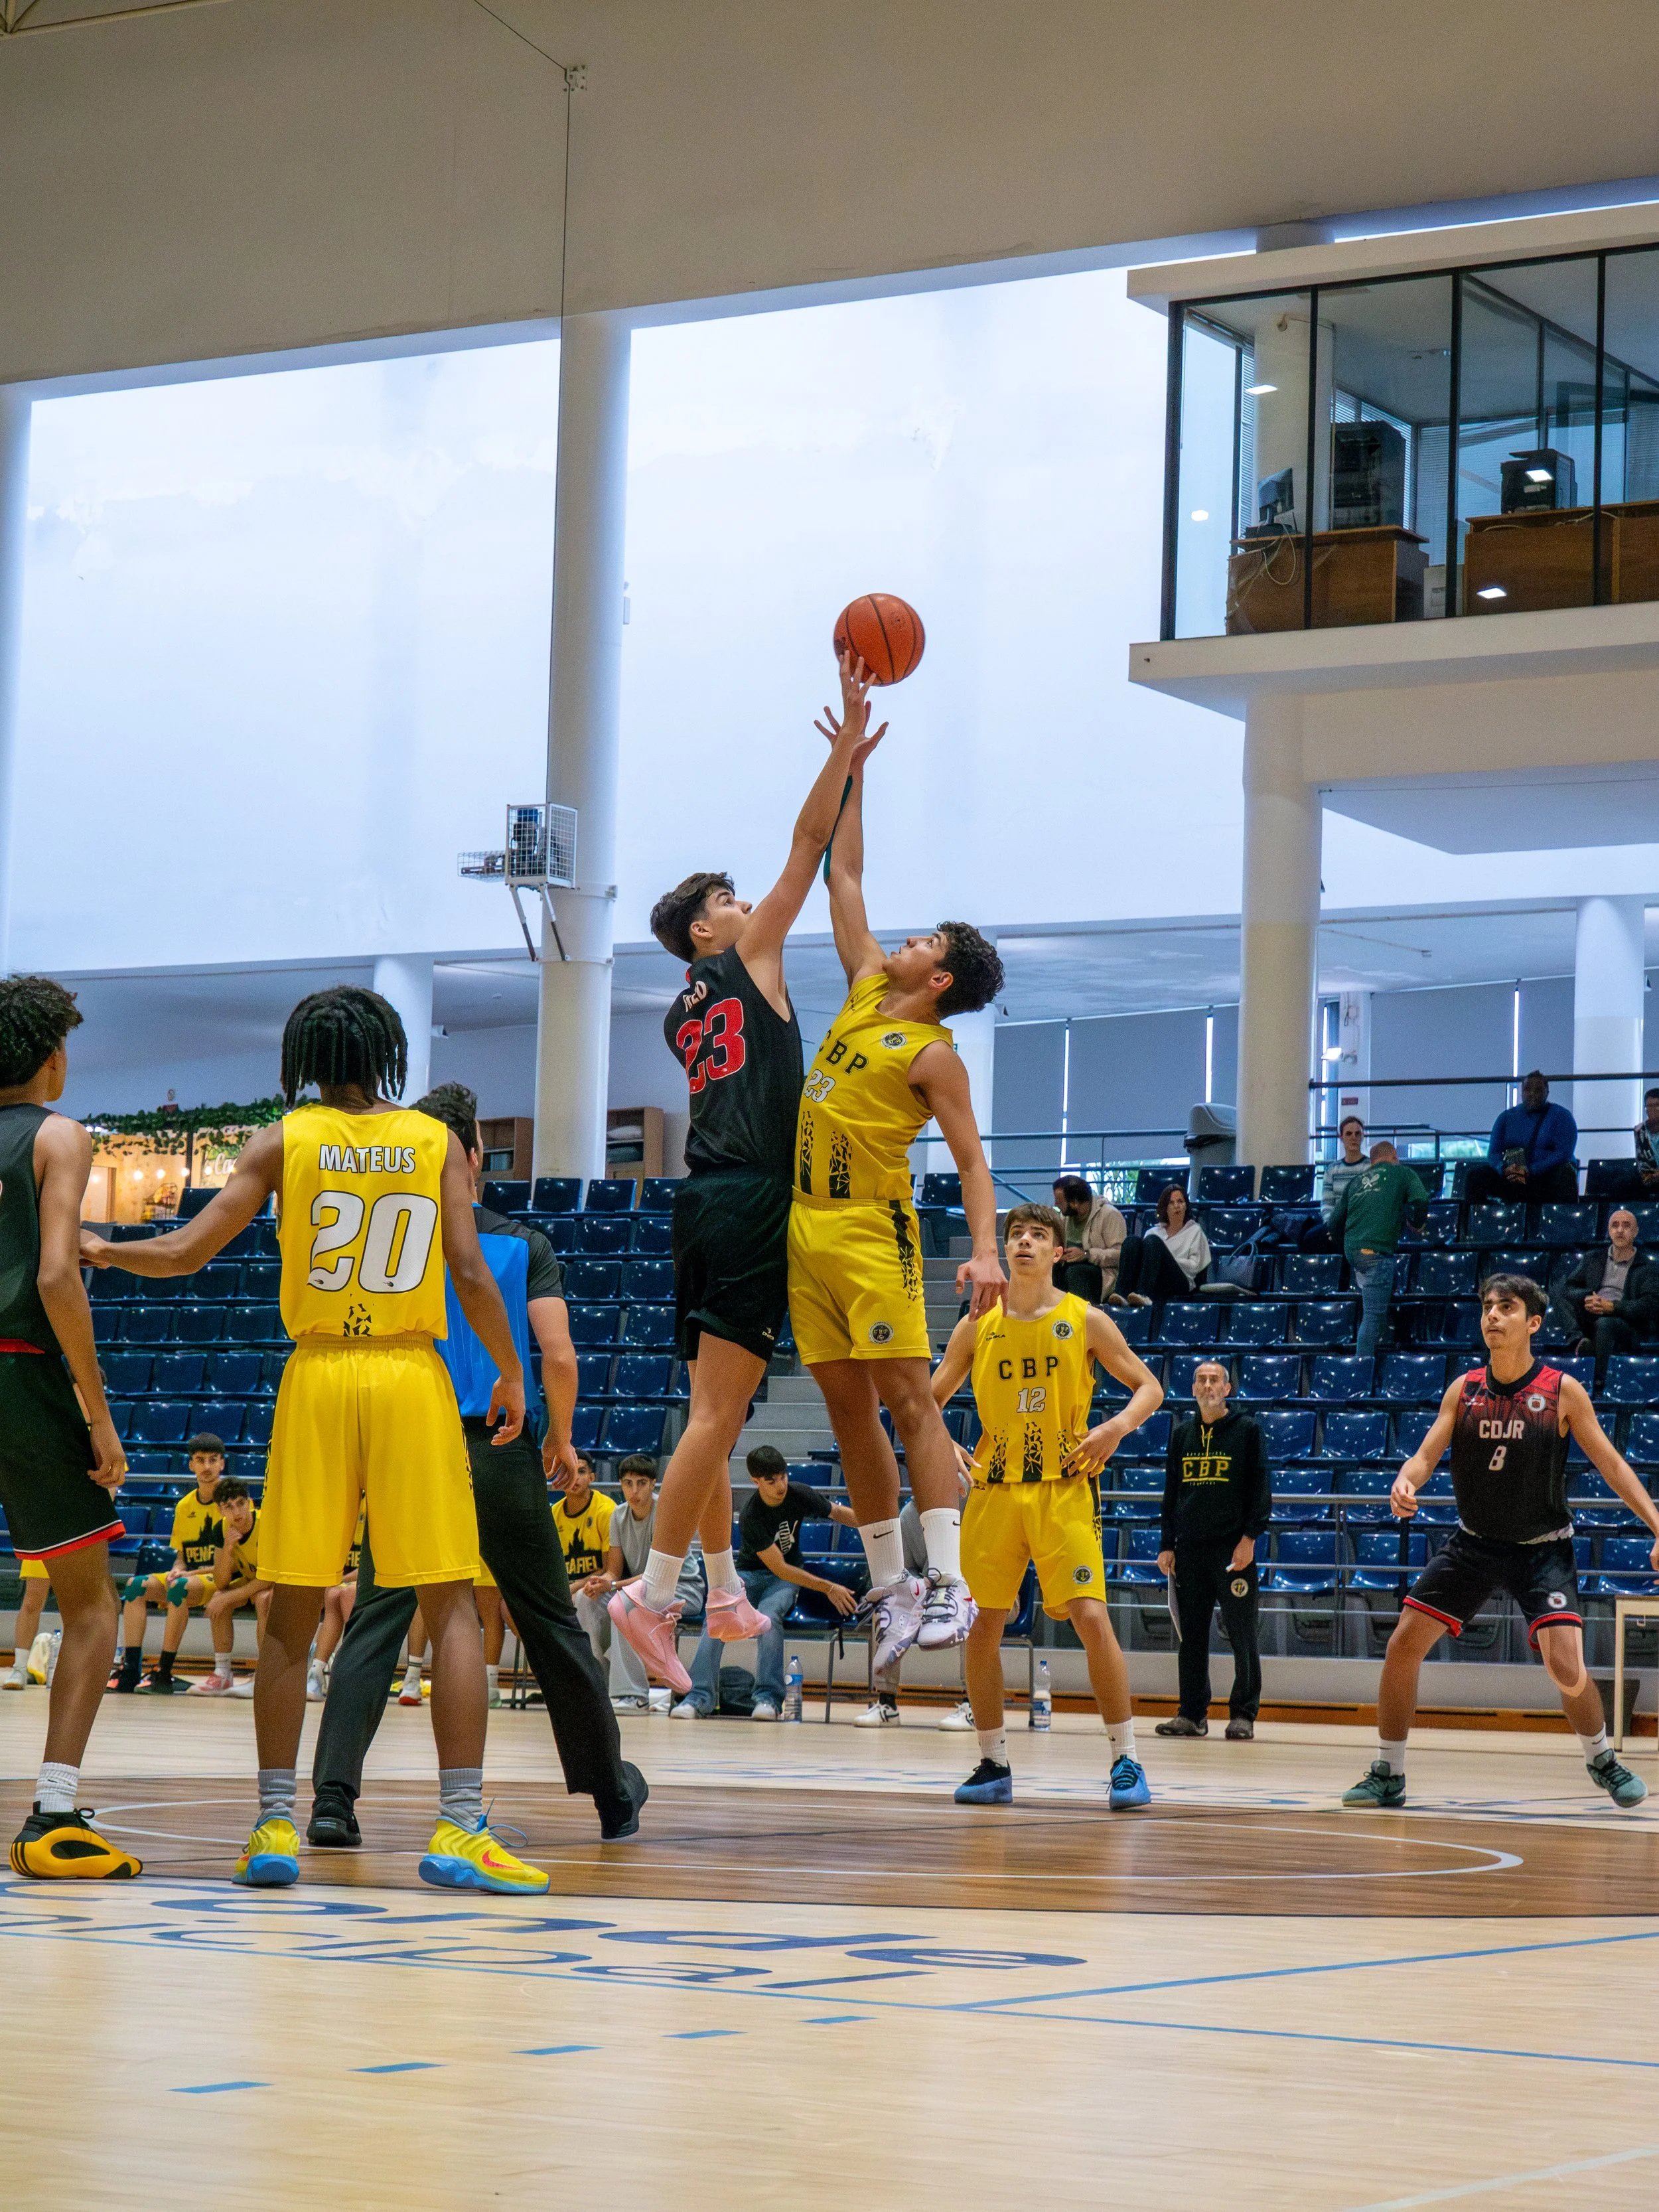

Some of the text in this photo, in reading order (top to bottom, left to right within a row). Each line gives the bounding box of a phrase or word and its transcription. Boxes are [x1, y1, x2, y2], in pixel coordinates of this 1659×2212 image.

[676, 997, 746, 1094] 23
[804, 1069, 836, 1103] 23
[214, 1152, 237, 1175] Ca
[319, 1144, 415, 1174] MATEUS
[307, 1190, 439, 1293] 20
[998, 1355, 1059, 1381] CBP
[1016, 1386, 1046, 1414] 12
[1479, 1419, 1525, 1439] CDJR
[1183, 1460, 1229, 1477] CBP
[1488, 1445, 1507, 1471] 8
[0, 1881, 1087, 1969] Conde
